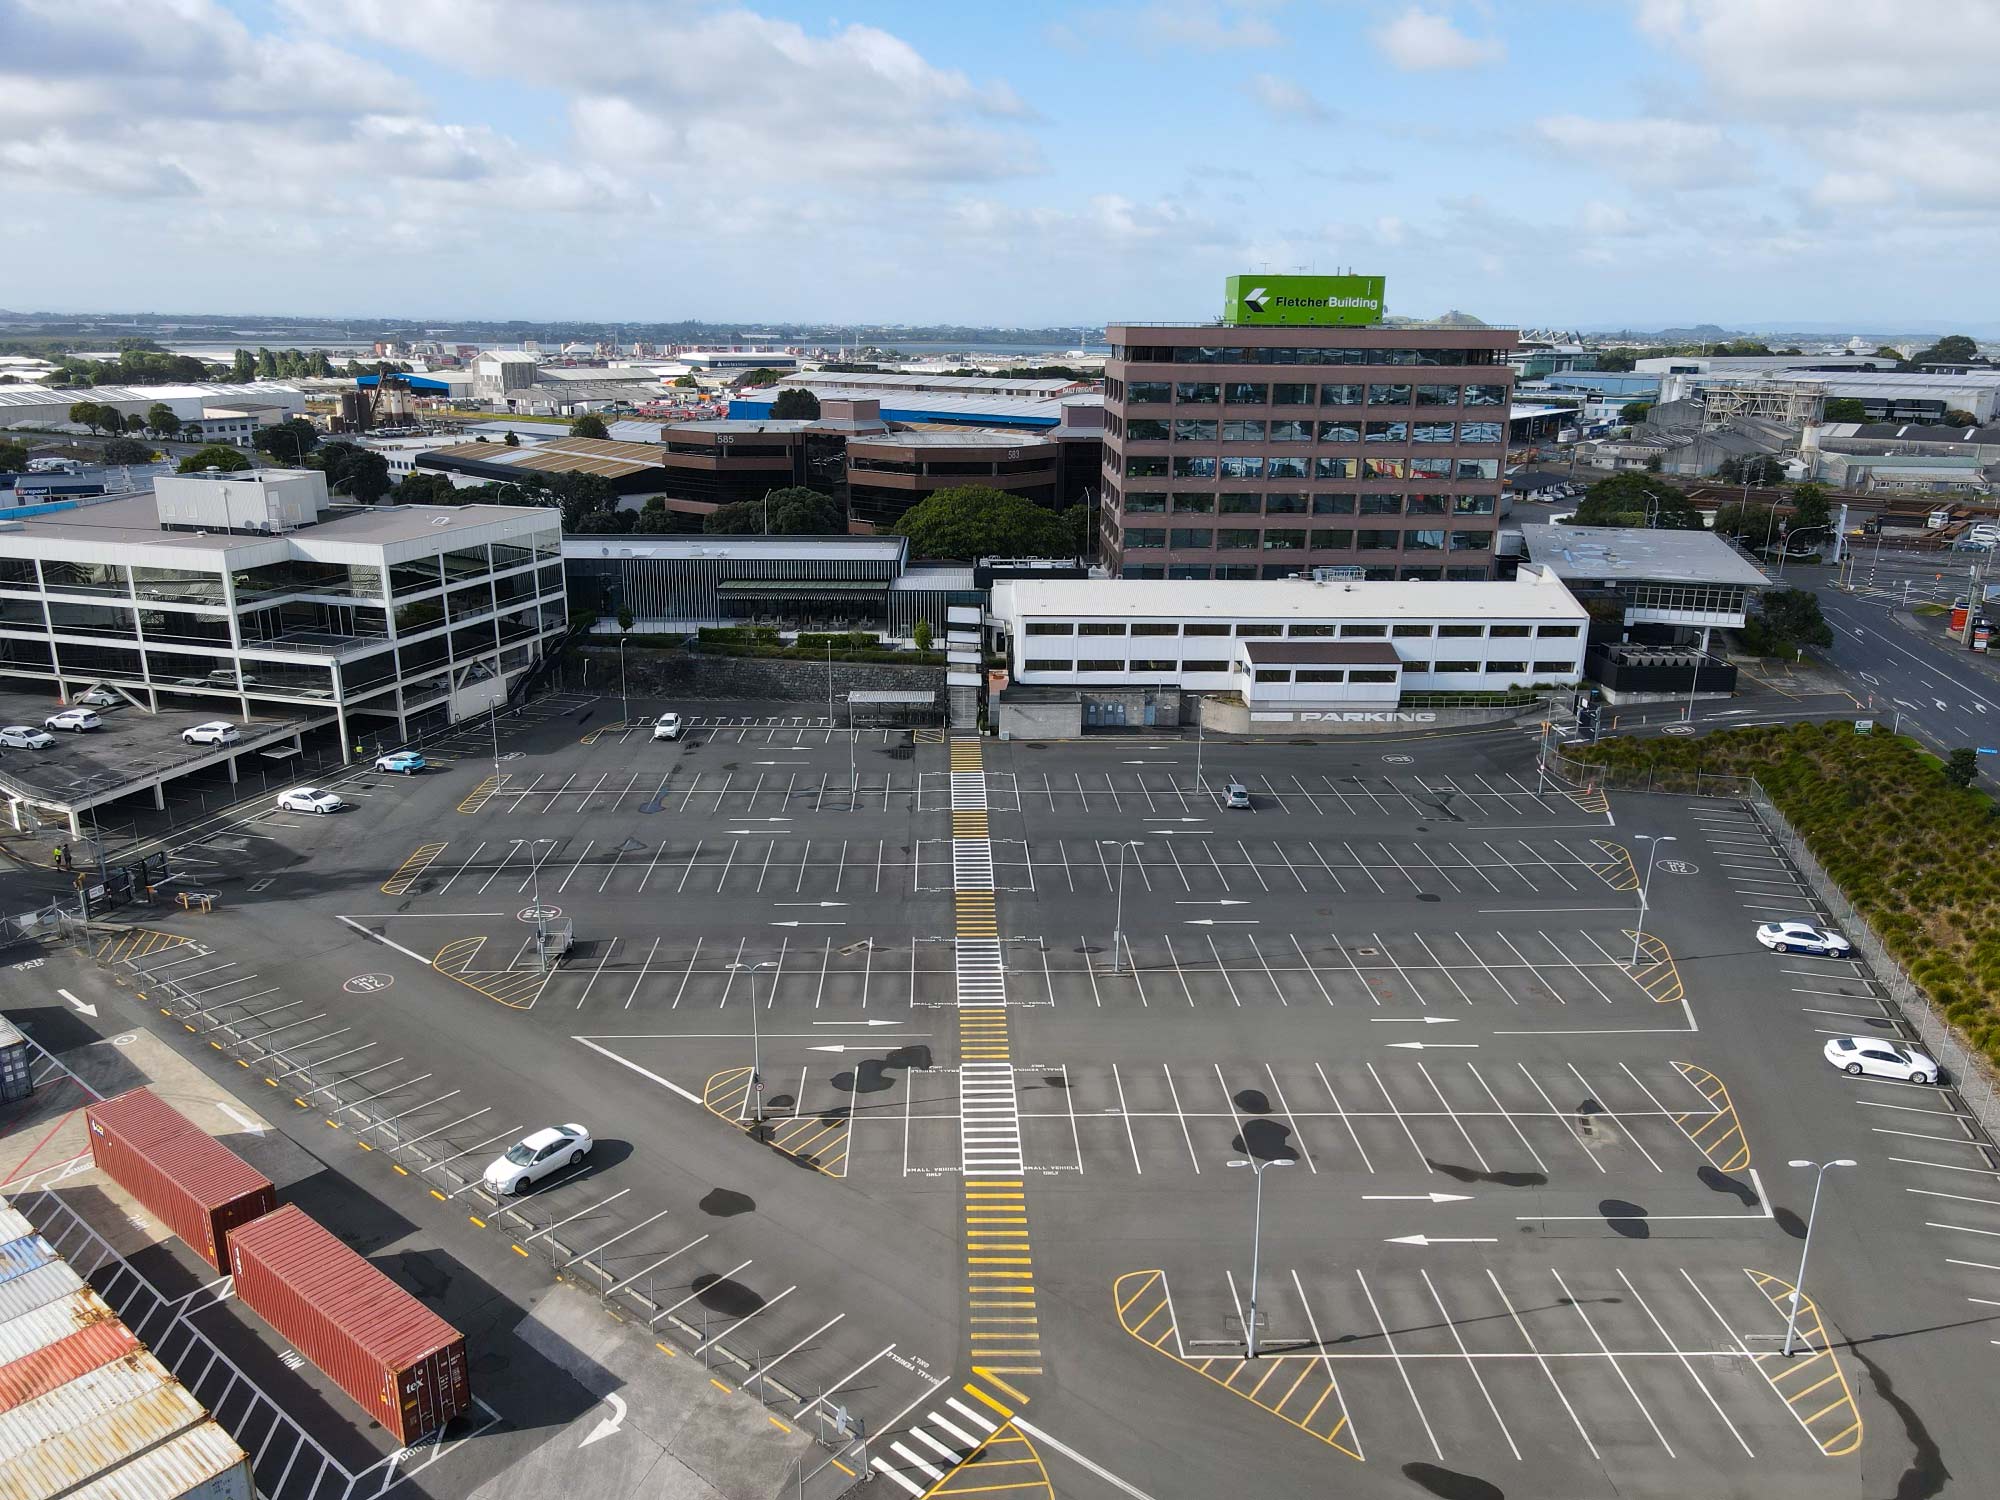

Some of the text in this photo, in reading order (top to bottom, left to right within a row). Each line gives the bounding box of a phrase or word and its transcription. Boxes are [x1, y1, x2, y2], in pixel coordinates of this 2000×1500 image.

[717, 435, 734, 443] 585
[1300, 712, 1437, 722] PARKING
[405, 1378, 424, 1394] tex
